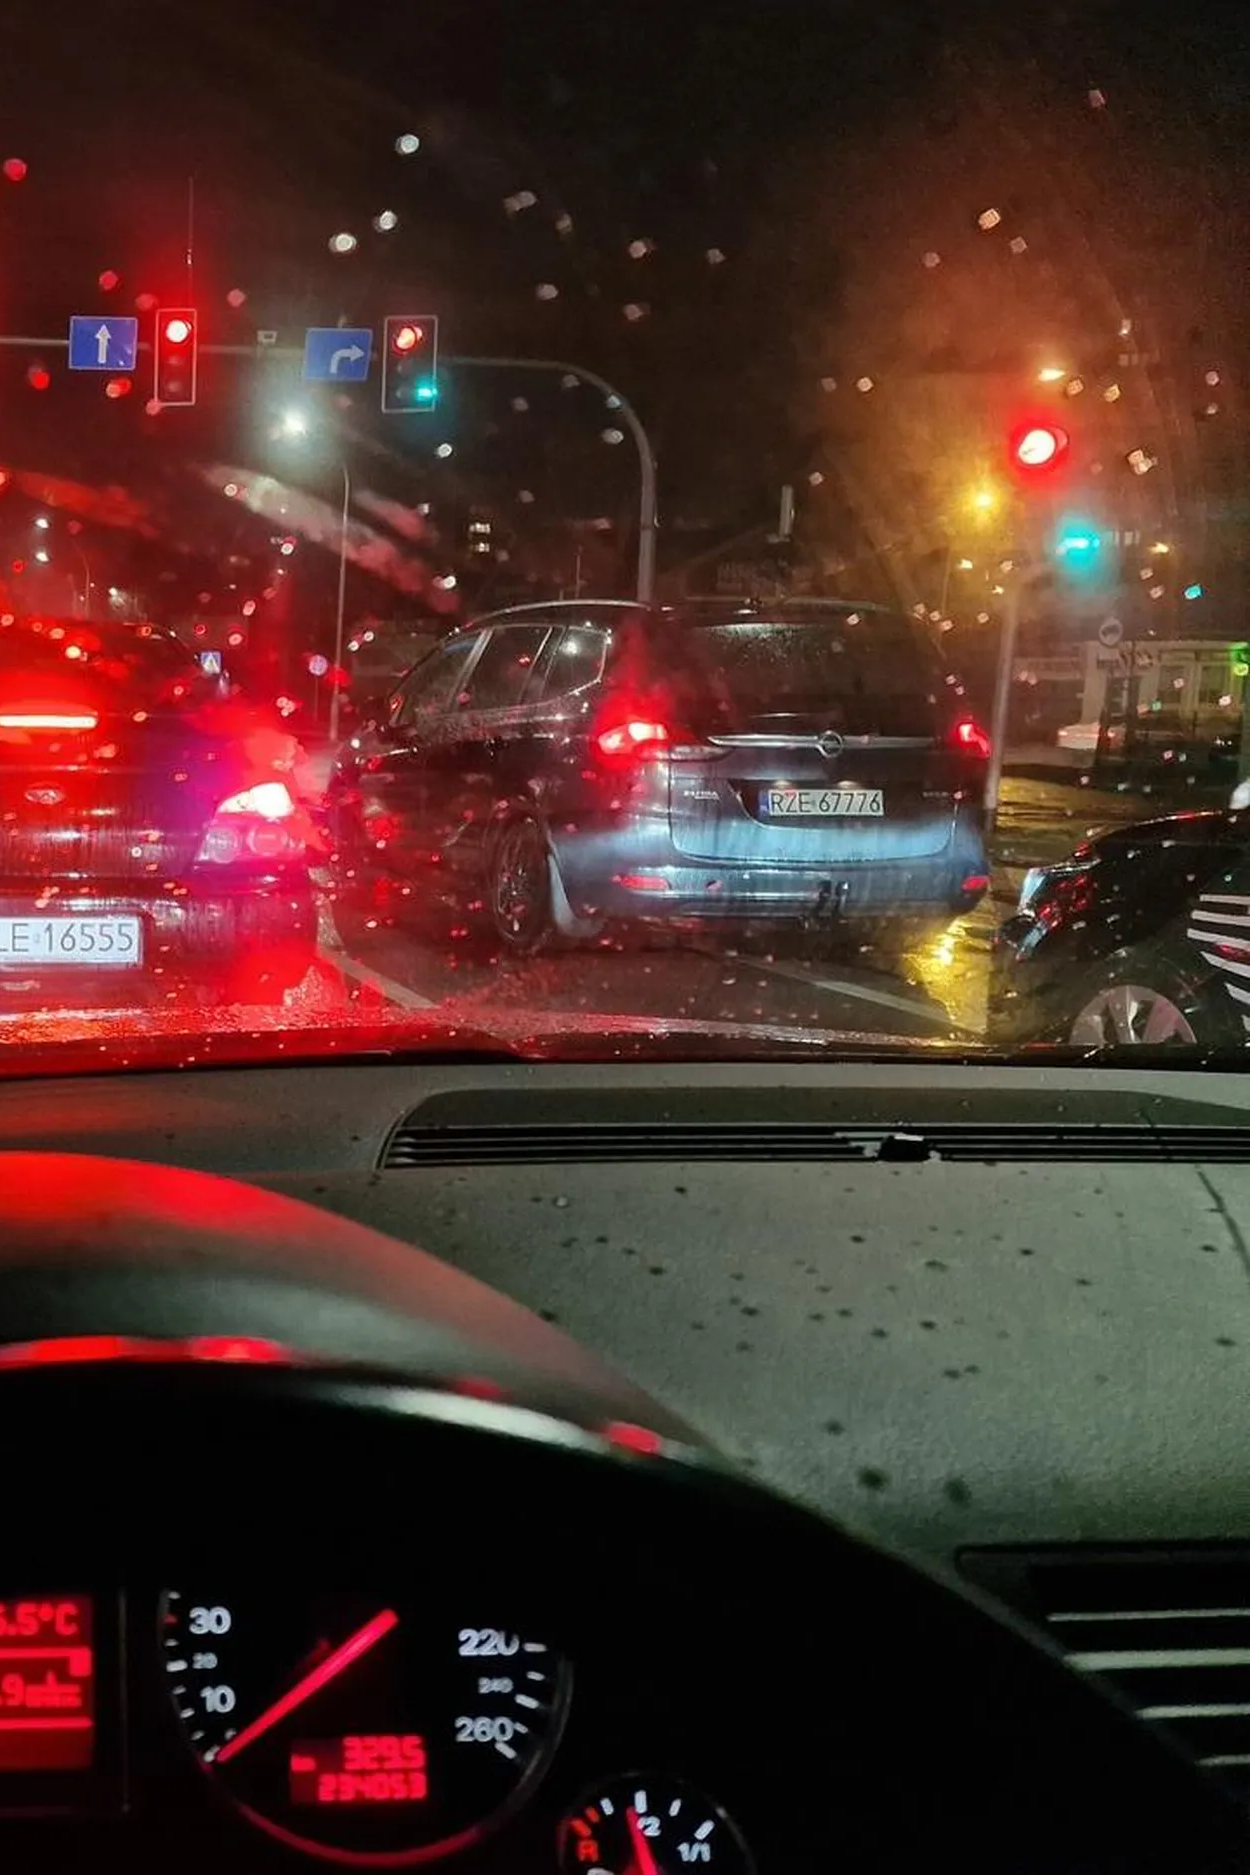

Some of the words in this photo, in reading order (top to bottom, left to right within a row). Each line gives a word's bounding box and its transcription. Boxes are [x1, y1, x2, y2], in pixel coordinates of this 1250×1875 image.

[771, 792, 811, 813] RZE
[818, 792, 881, 813] 67776
[44, 922, 134, 952] 16555
[189, 1606, 232, 1635] 30
[458, 1628, 520, 1656] 220
[200, 1684, 236, 1713] 10
[455, 1716, 514, 1742] 260
